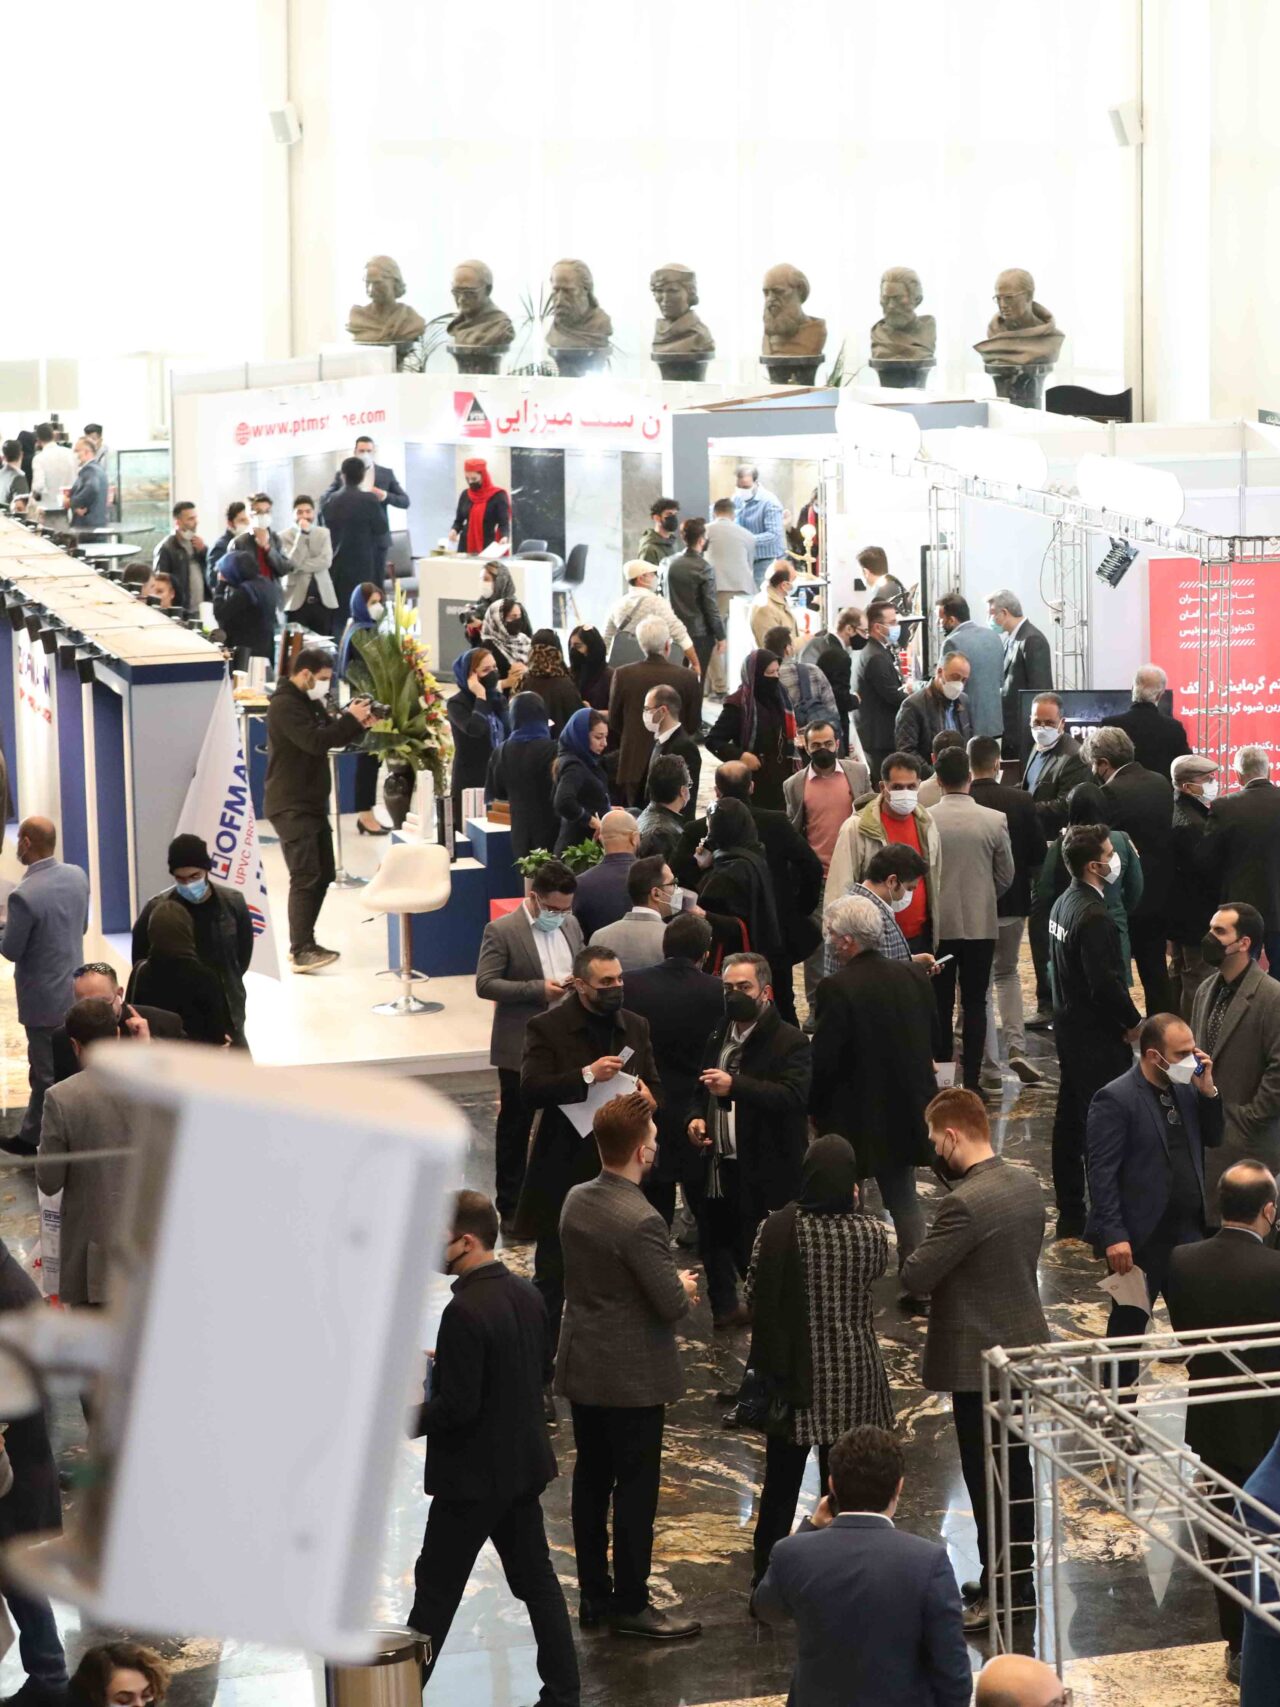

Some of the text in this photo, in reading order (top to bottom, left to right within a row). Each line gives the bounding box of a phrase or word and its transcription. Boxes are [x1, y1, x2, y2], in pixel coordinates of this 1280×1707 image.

[251, 409, 386, 438] www.ptmse.com
[496, 398, 573, 434] میرزایی
[208, 741, 249, 880] HOFMA
[234, 849, 252, 886] UPVC
